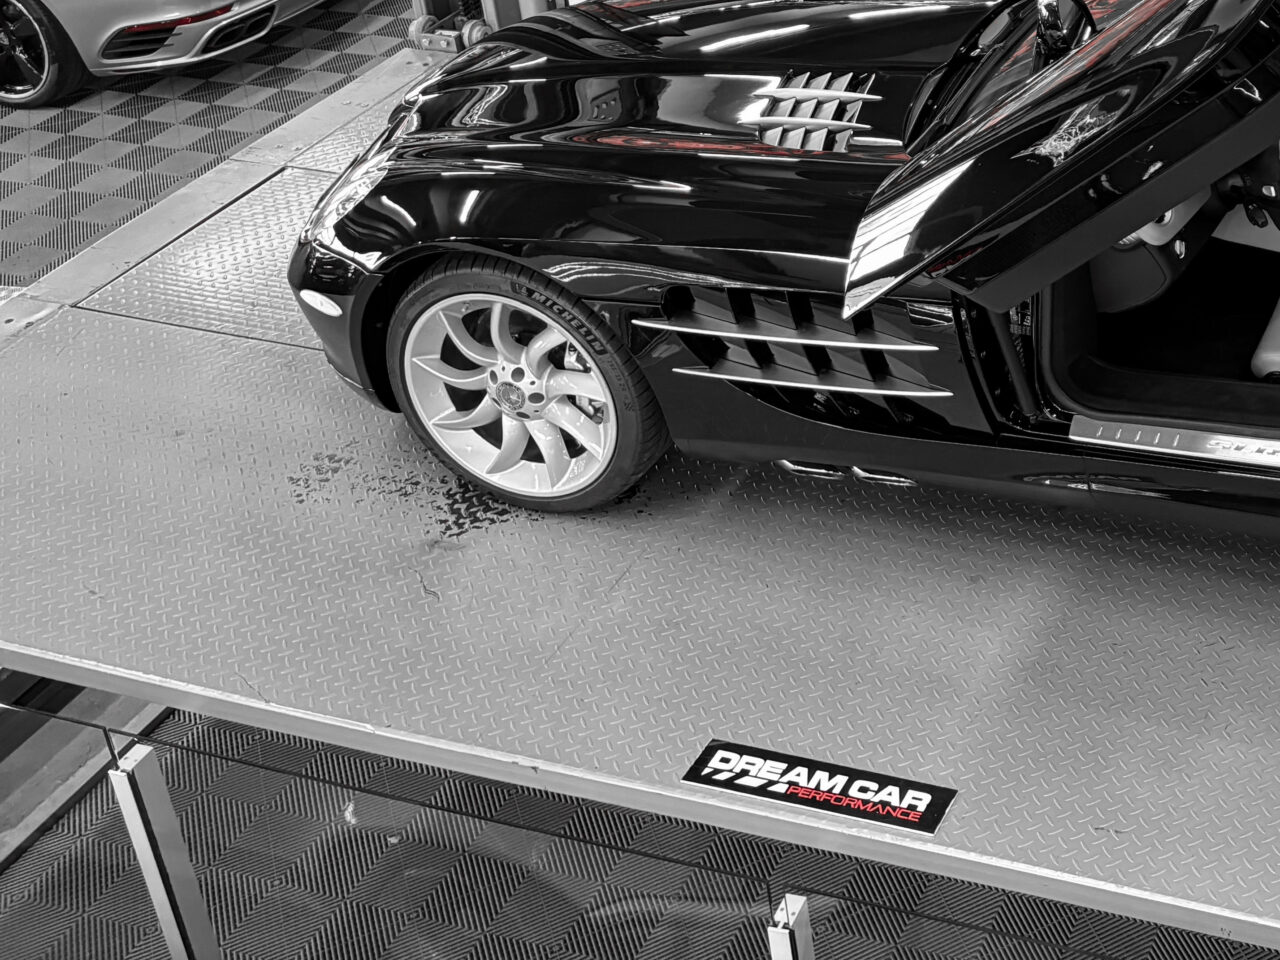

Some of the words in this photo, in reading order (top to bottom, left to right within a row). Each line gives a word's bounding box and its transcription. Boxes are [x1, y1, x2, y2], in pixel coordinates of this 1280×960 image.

[531, 292, 605, 351] MICHELIN
[707, 749, 849, 794] DREAM
[848, 779, 932, 812] CAR
[786, 784, 922, 822] PERFORMANCE
